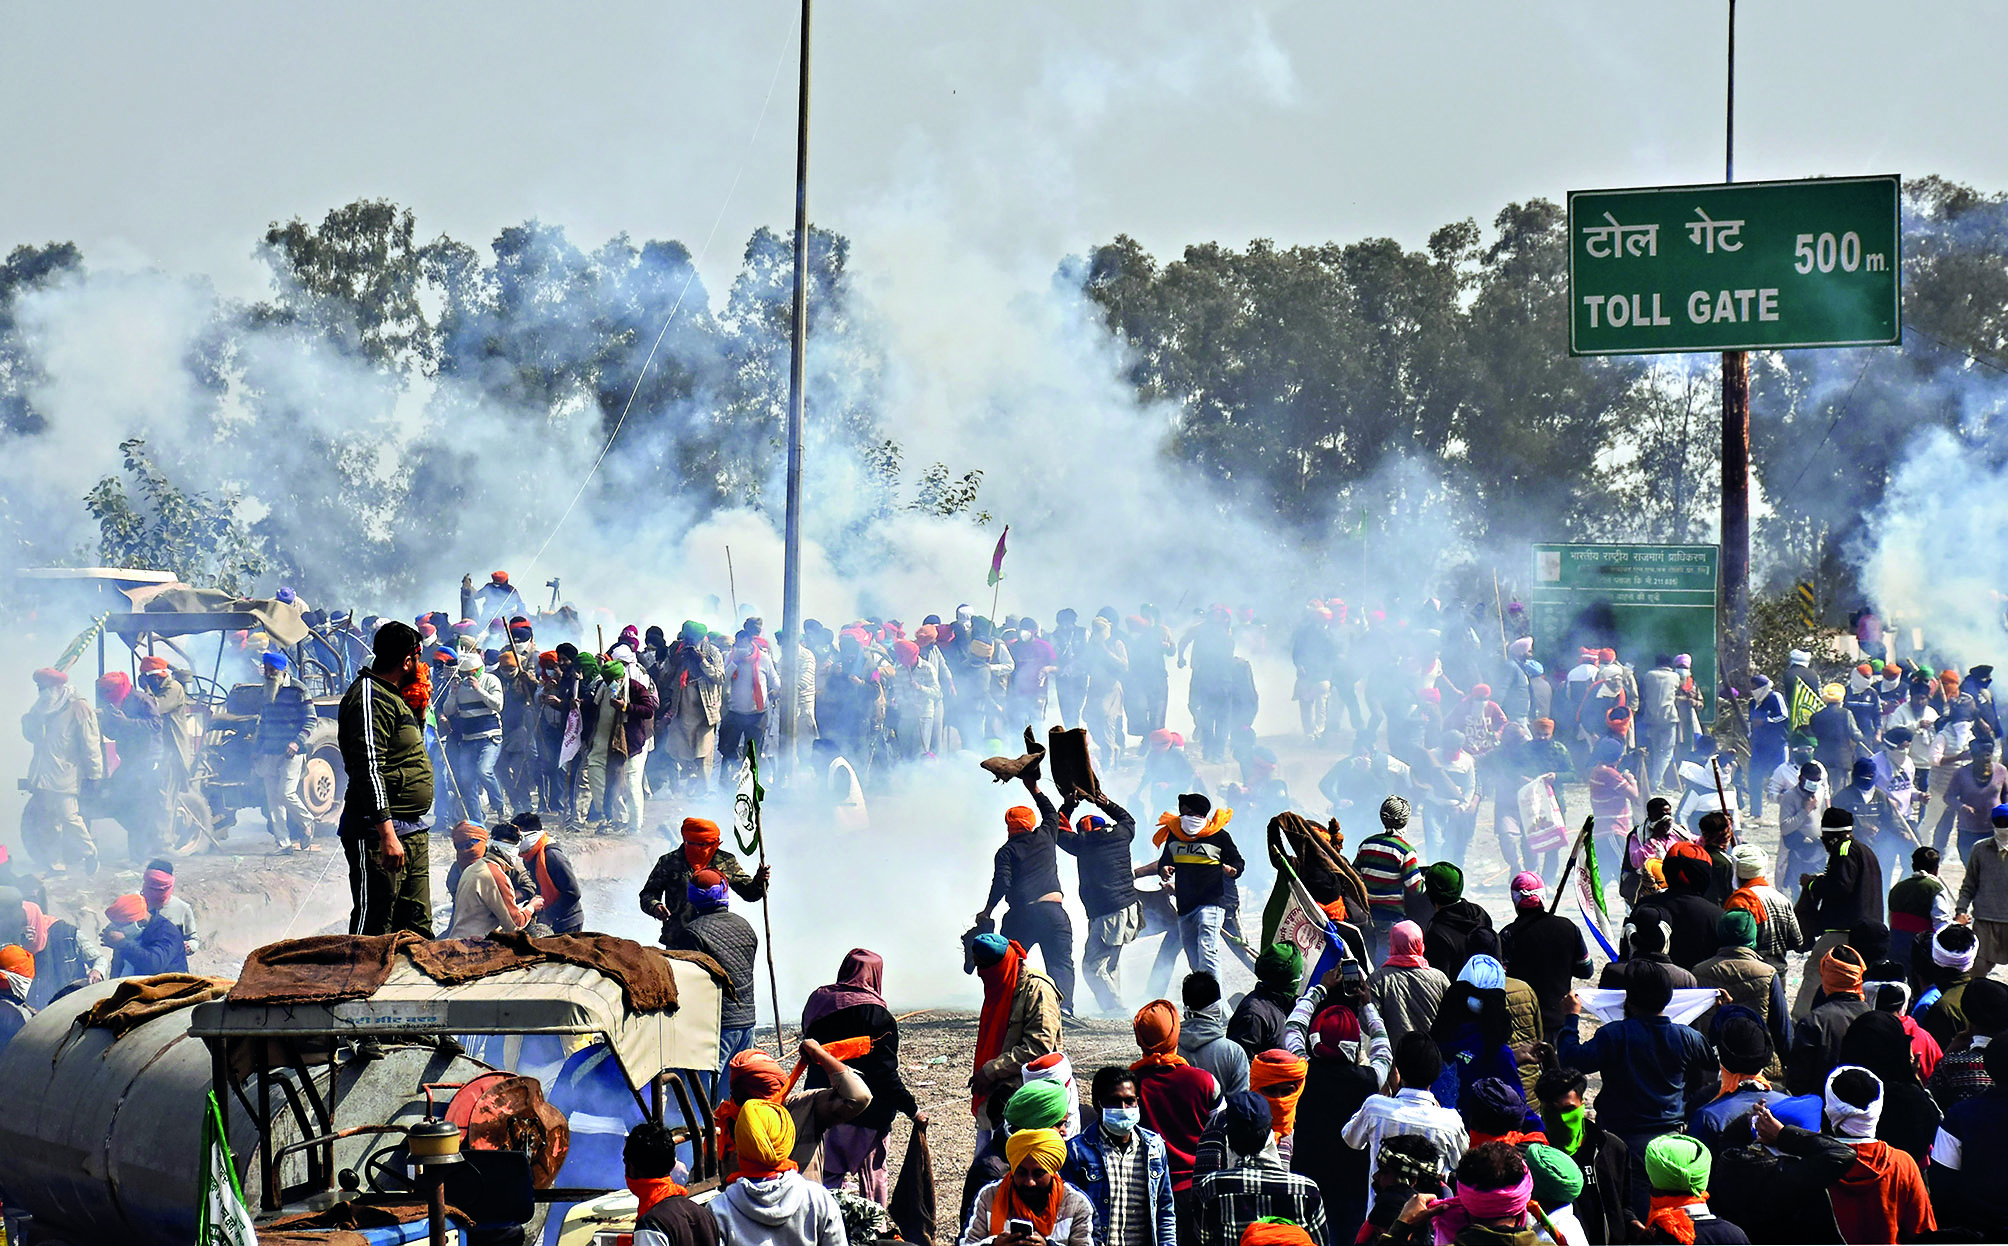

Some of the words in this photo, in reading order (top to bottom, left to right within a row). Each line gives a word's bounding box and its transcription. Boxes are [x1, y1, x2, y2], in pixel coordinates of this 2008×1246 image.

[1582, 211, 1660, 259] टोल
[1685, 206, 1745, 254] गेट
[1794, 230, 1861, 275] 500
[1583, 293, 1671, 329] TOLL
[1687, 288, 1780, 324] GATE
[1570, 549, 1599, 561] भारतीय
[1603, 549, 1629, 563] राष्ट्रीय
[1633, 550, 1664, 562] राजमार्ग
[1668, 550, 1706, 562] प्राधिकरण
[1176, 842, 1208, 856] FILA
